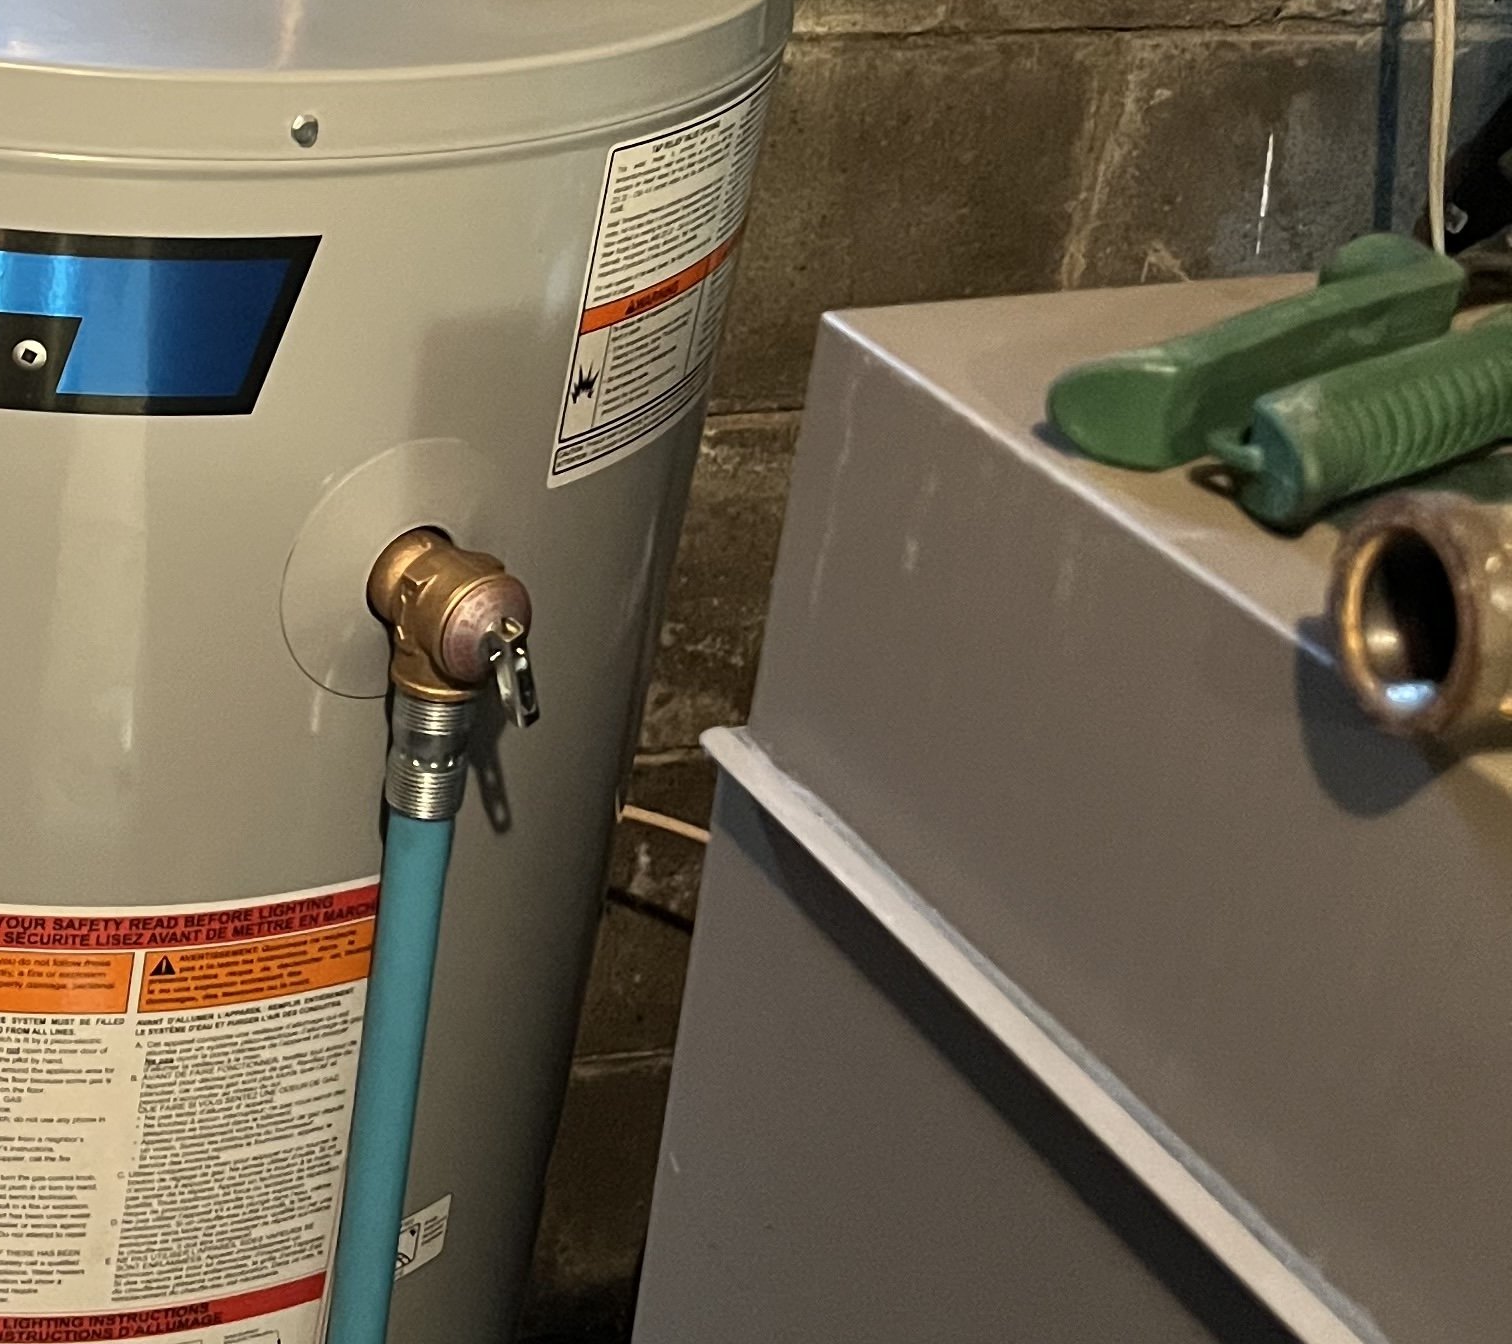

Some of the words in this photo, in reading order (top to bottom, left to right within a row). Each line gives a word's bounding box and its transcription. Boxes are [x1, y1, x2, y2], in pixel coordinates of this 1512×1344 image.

[52, 917, 124, 932] SAFETY
[129, 915, 182, 932] READ
[184, 909, 253, 929] BEFORE
[258, 895, 334, 920] LIGHTING
[95, 931, 144, 946] LISEZ
[147, 928, 203, 946] AVANT
[205, 925, 226, 941] DE
[231, 917, 294, 938] METTRE
[298, 911, 319, 927] EN
[2, 1317, 84, 1330] LIGHTING
[88, 1302, 210, 1327] INSTRUCTIONS
[118, 1312, 223, 1338] D'ALLUMAGE
